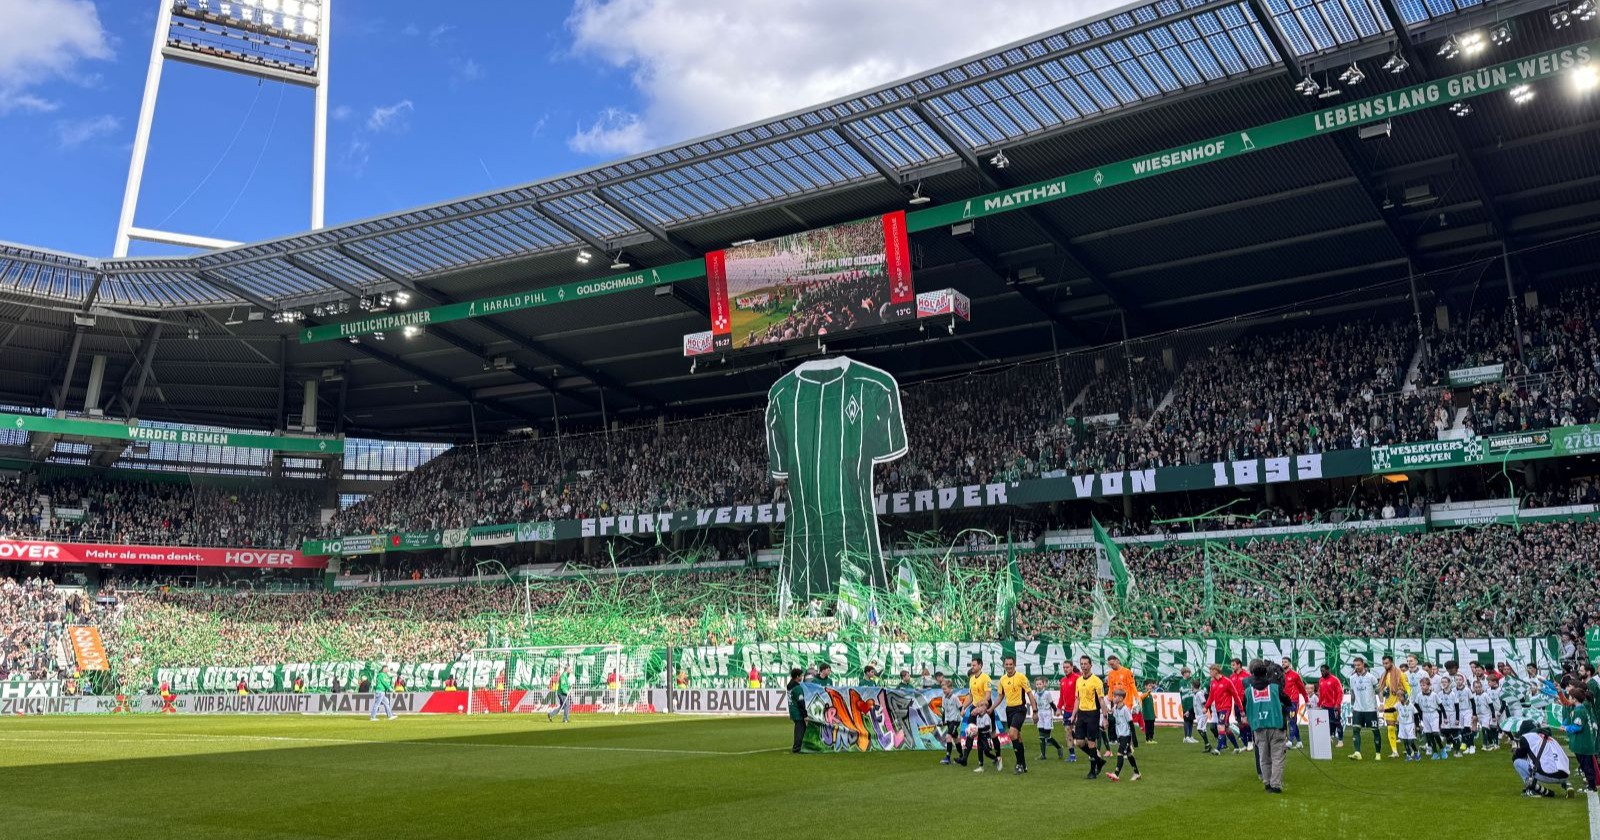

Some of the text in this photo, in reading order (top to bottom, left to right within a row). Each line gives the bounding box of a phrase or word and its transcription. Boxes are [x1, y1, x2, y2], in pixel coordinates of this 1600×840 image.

[1314, 46, 1591, 131] LEBENSLANG GRÜN-WEISS
[1132, 141, 1225, 175] WIESENHOF
[984, 181, 1066, 211] MATTHÄI
[576, 274, 644, 295] GOLDSCHMAUS
[482, 292, 547, 312] HARALD PIHL
[340, 310, 431, 335] FLUTLICHTPARTNER
[128, 427, 228, 445] WERDER BREMEN
[1490, 435, 1533, 448] AMMERLAND
[1389, 440, 1464, 456] WESERTIGERS
[1403, 452, 1452, 464] HOPSTEN
[1072, 469, 1156, 498] VON
[1212, 453, 1323, 487] 1899
[86, 549, 117, 558] Mehr
[120, 551, 137, 559] als
[166, 552, 204, 561] denkt.
[225, 552, 294, 565] HOYER
[322, 541, 341, 553] HO
[680, 645, 735, 676] AUF
[856, 641, 1003, 676] WERDER
[1229, 637, 1326, 679] UND
[157, 667, 201, 690] WER
[2, 697, 80, 714] ZUKUNFT
[193, 696, 214, 712] WIR
[217, 695, 254, 712] BAUEN
[257, 694, 311, 712] ZUKUNFT
[318, 693, 414, 712] MATTÄI
[667, 690, 701, 710] WIR
[706, 690, 770, 711] BAUEN
[1258, 711, 1269, 720] 17
